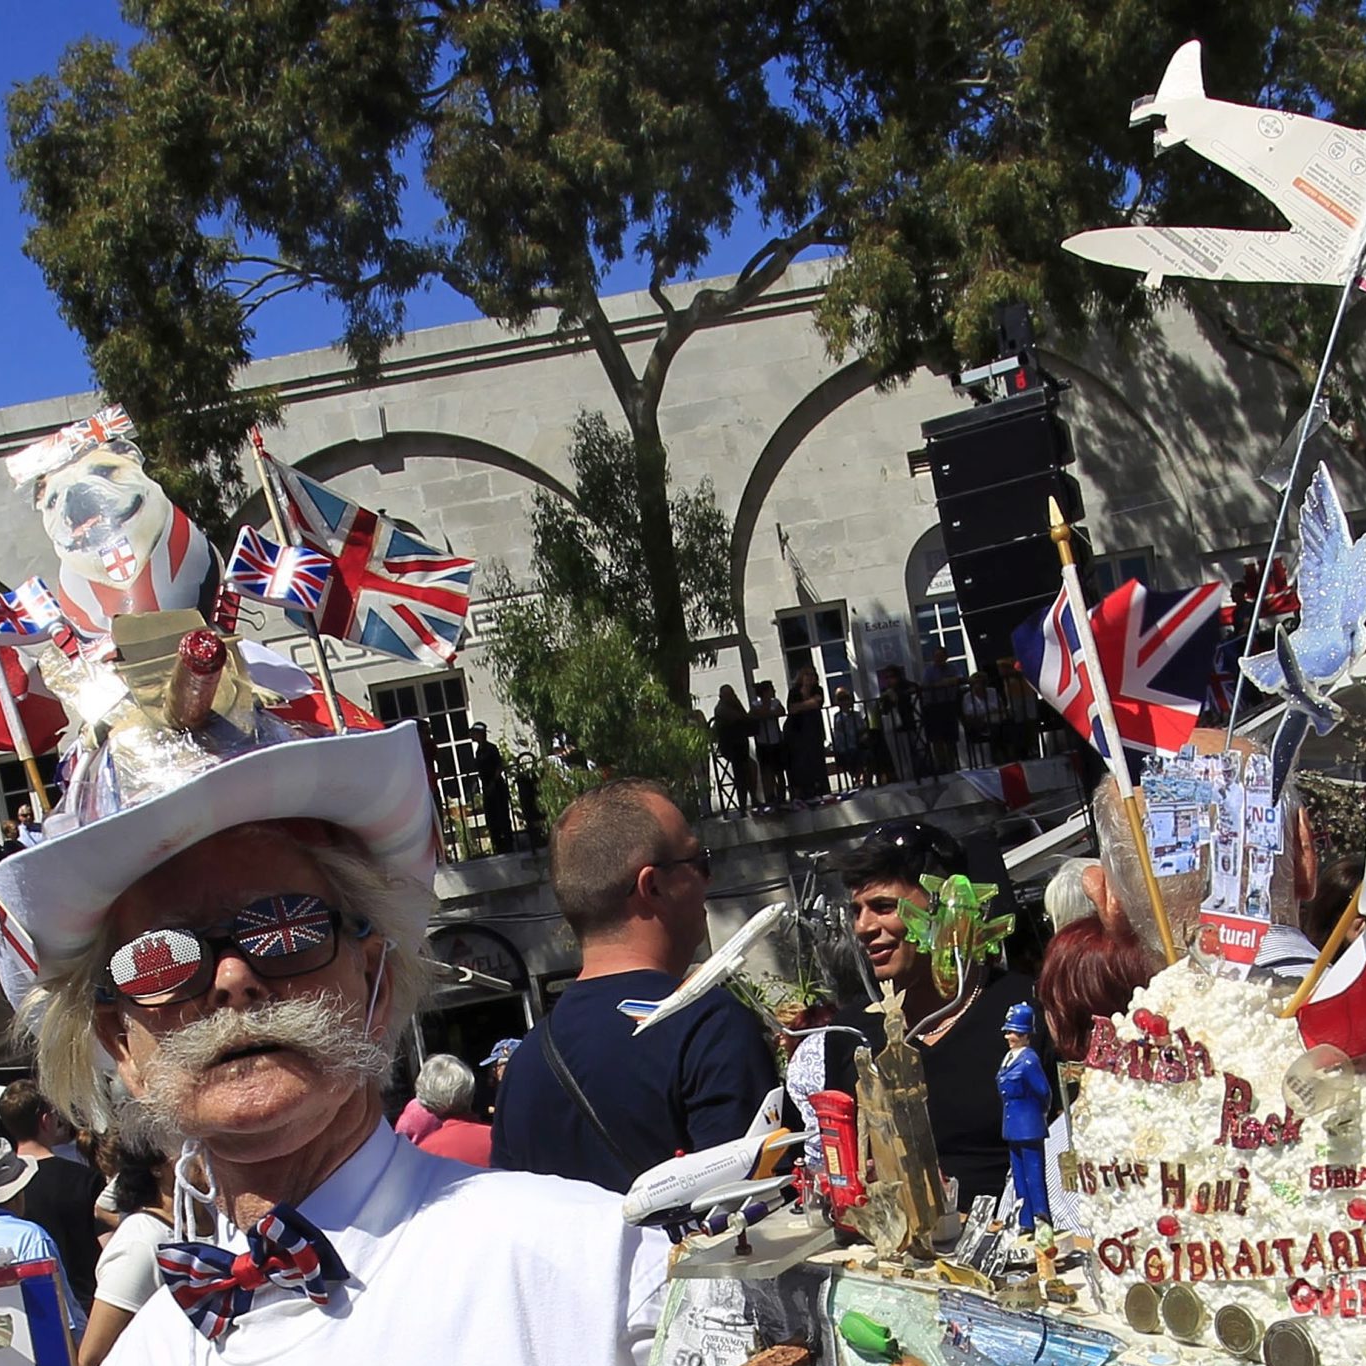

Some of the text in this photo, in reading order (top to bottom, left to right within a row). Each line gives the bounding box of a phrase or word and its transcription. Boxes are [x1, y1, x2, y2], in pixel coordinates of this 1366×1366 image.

[1085, 1014, 1216, 1084] British
[1213, 1071, 1305, 1150] Rock
[1098, 1227, 1139, 1276] OF
